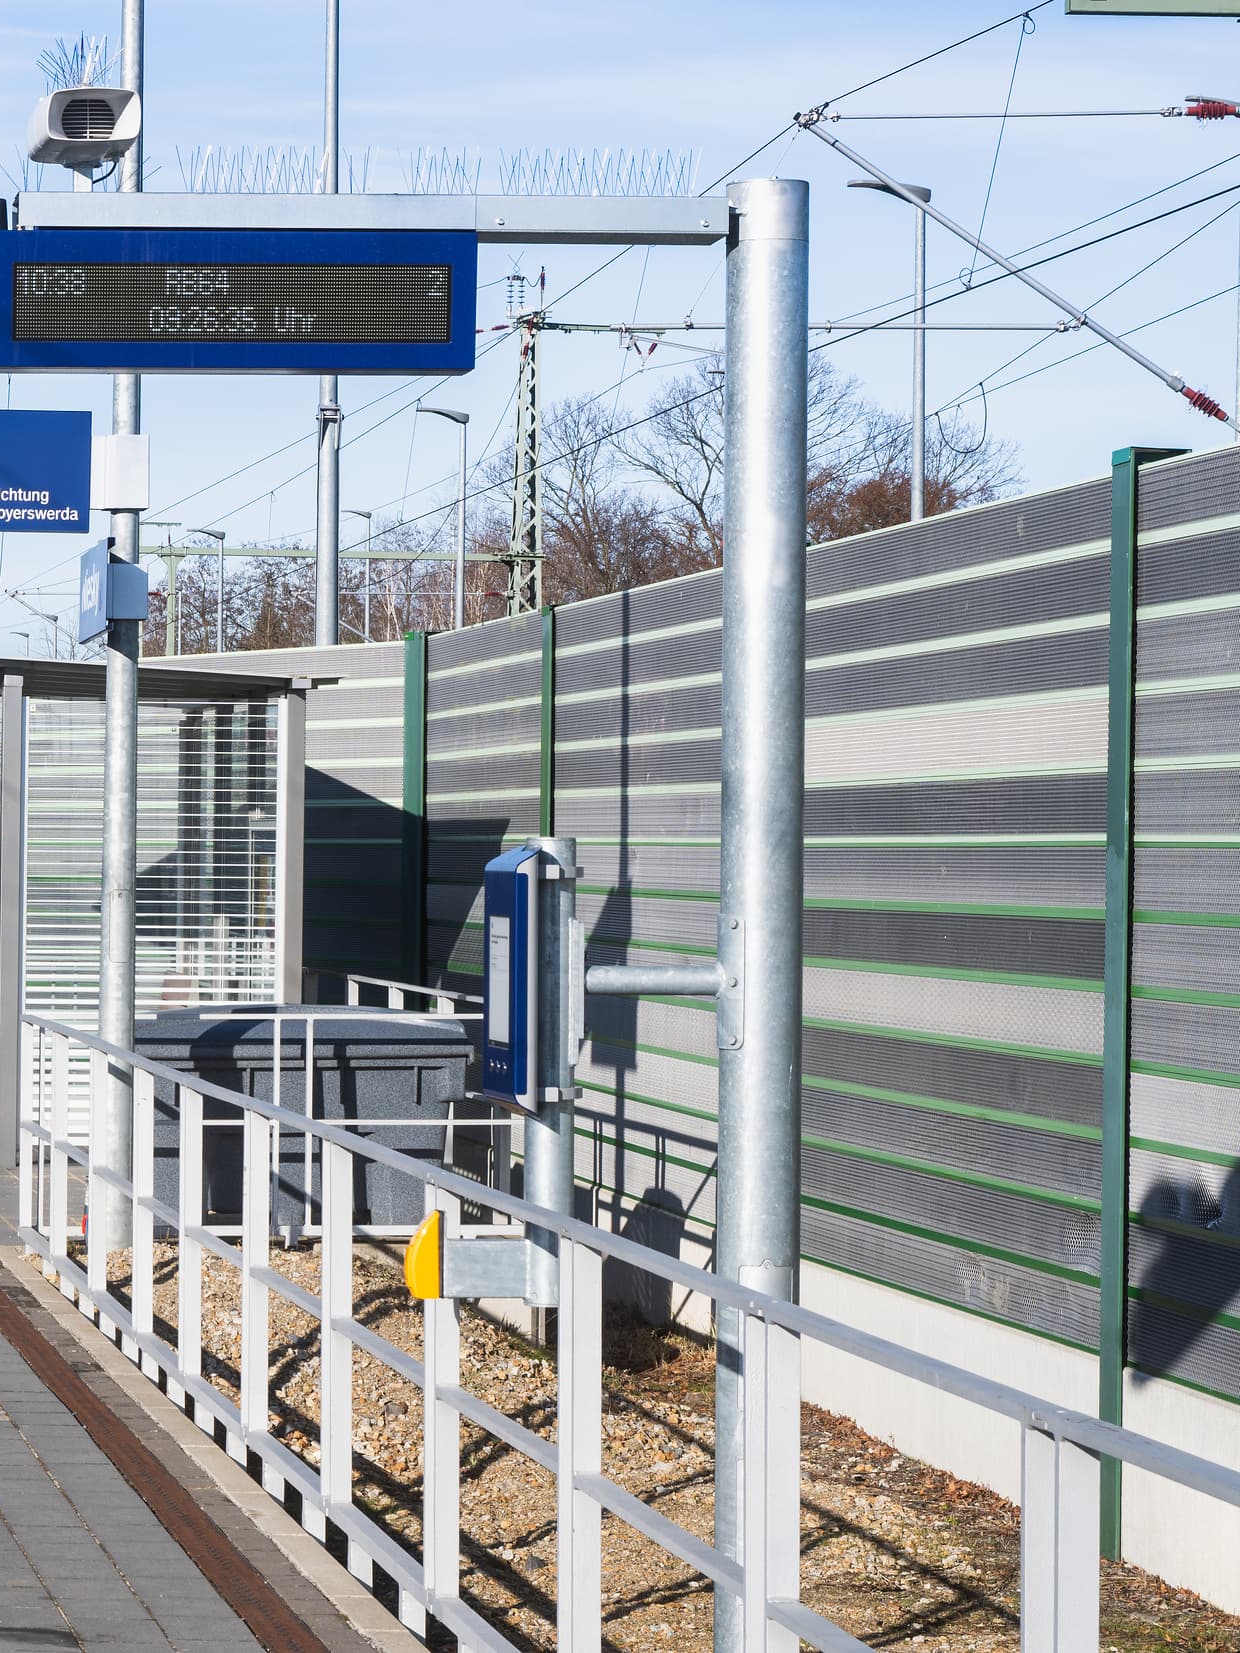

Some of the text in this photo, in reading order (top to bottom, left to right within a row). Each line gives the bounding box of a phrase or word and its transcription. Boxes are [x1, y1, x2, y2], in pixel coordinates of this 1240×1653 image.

[19, 269, 443, 296] 10:38 RB64 2
[149, 306, 316, 332] 09:26:35 Uhr
